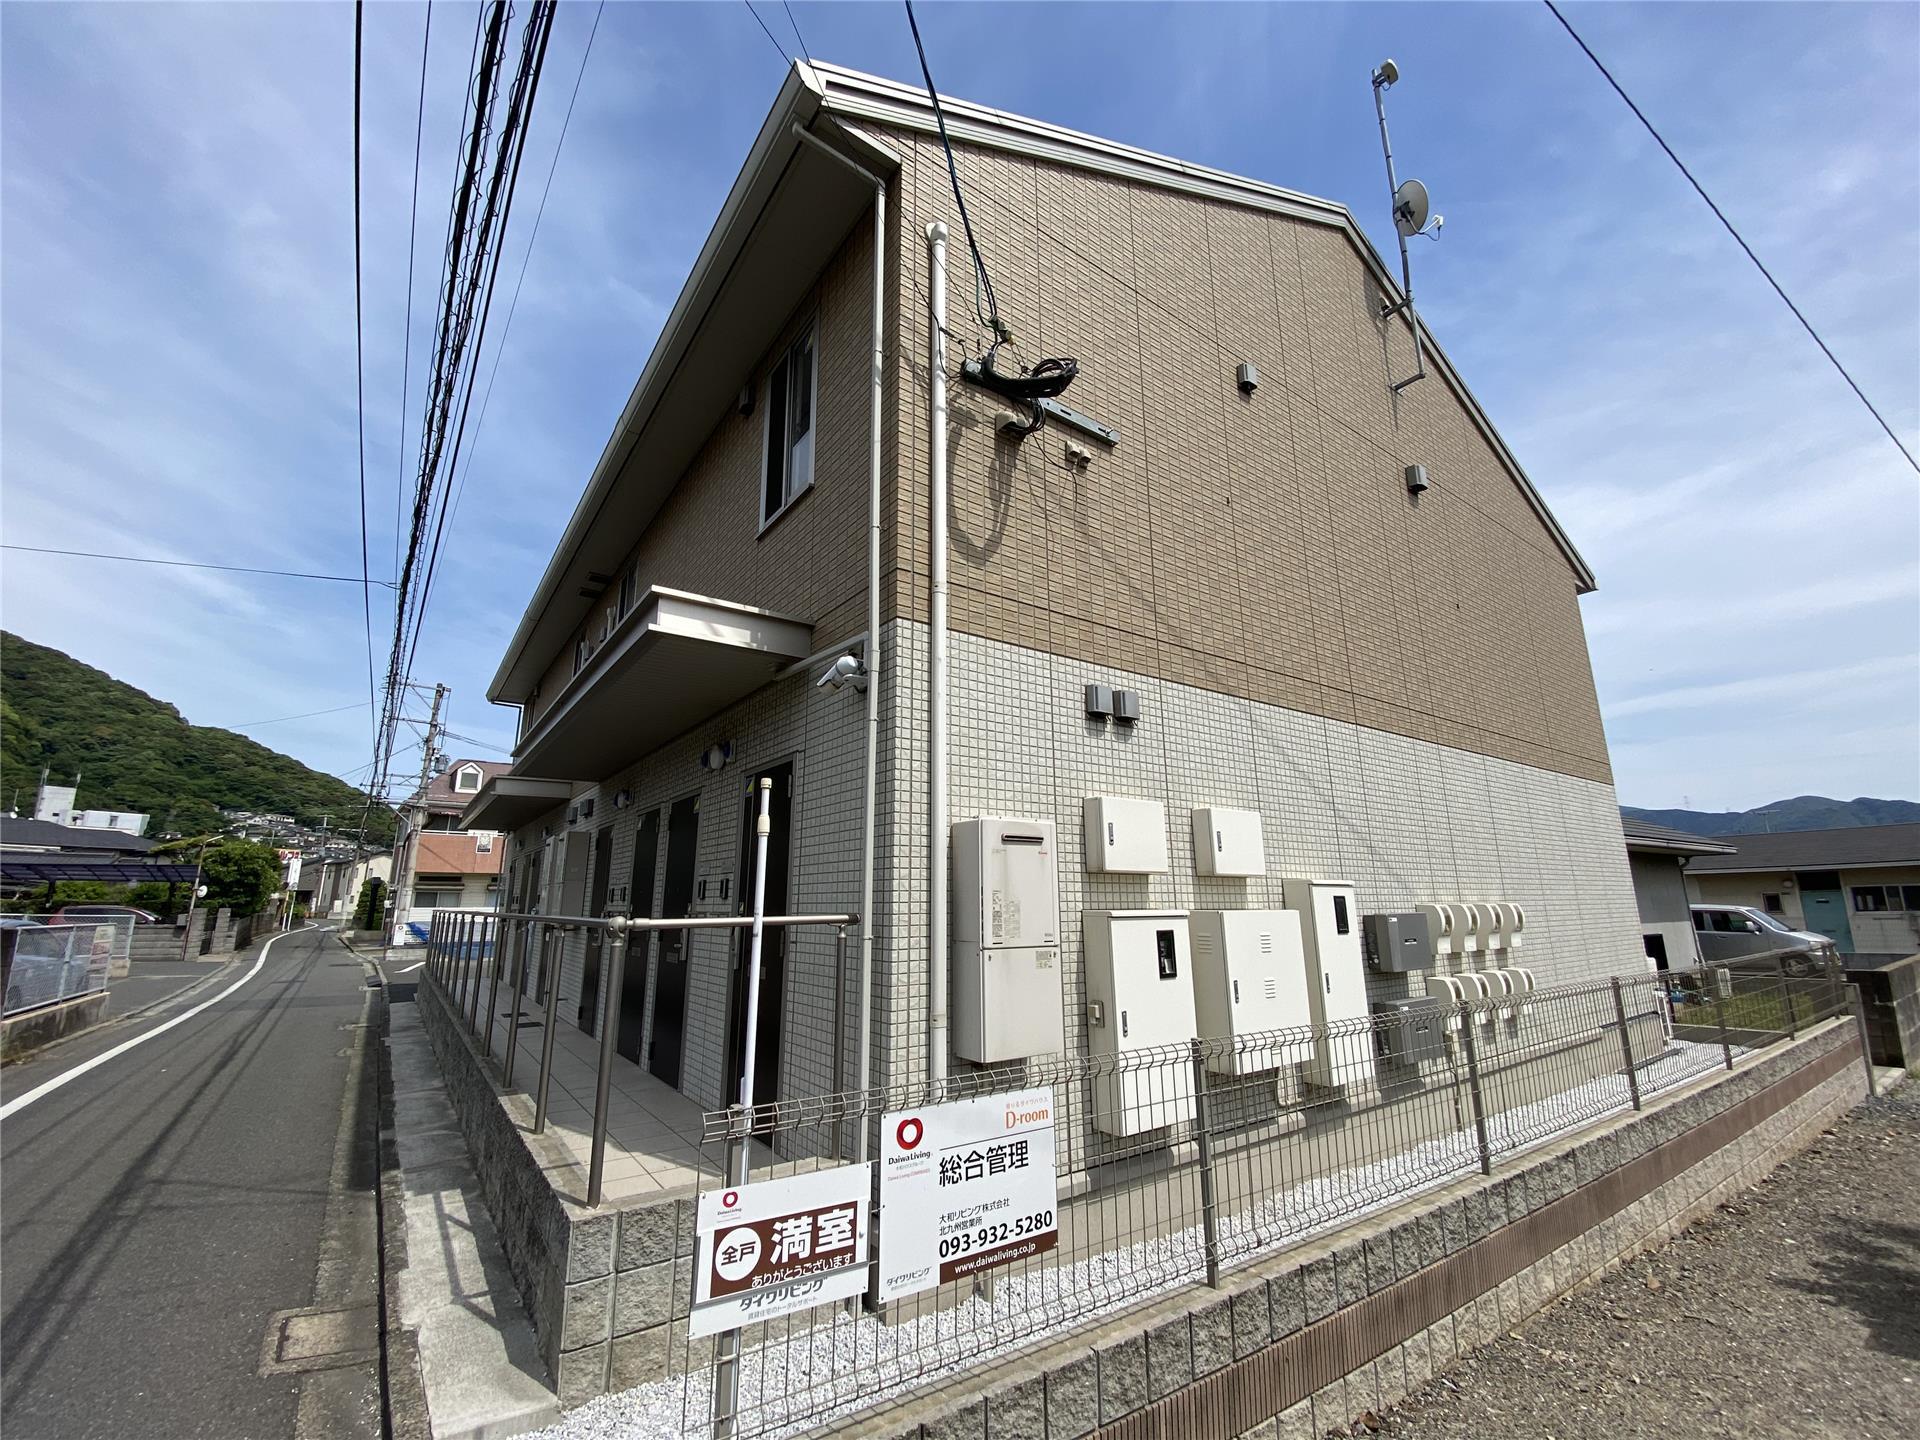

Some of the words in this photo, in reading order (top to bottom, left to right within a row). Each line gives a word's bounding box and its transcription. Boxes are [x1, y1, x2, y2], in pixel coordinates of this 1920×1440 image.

[1006, 1109, 1048, 1128] D-room
[888, 1154, 910, 1165] Daiwa
[910, 1151, 931, 1160] Living
[939, 1140, 1029, 1187] 総合管理
[939, 1198, 1010, 1224] 大和リビング株式会社
[770, 1208, 855, 1265] 満室
[939, 1216, 983, 1236] 北九州営業所
[939, 1210, 1053, 1258] 093-932-5280
[721, 1240, 757, 1266] 全戸
[954, 1242, 1036, 1274] www.daiwaliving.co.jp
[751, 1252, 853, 1288] ありがとうございます
[886, 1266, 932, 1286] ダイワリビング
[739, 1276, 828, 1311] ダイワリビング
